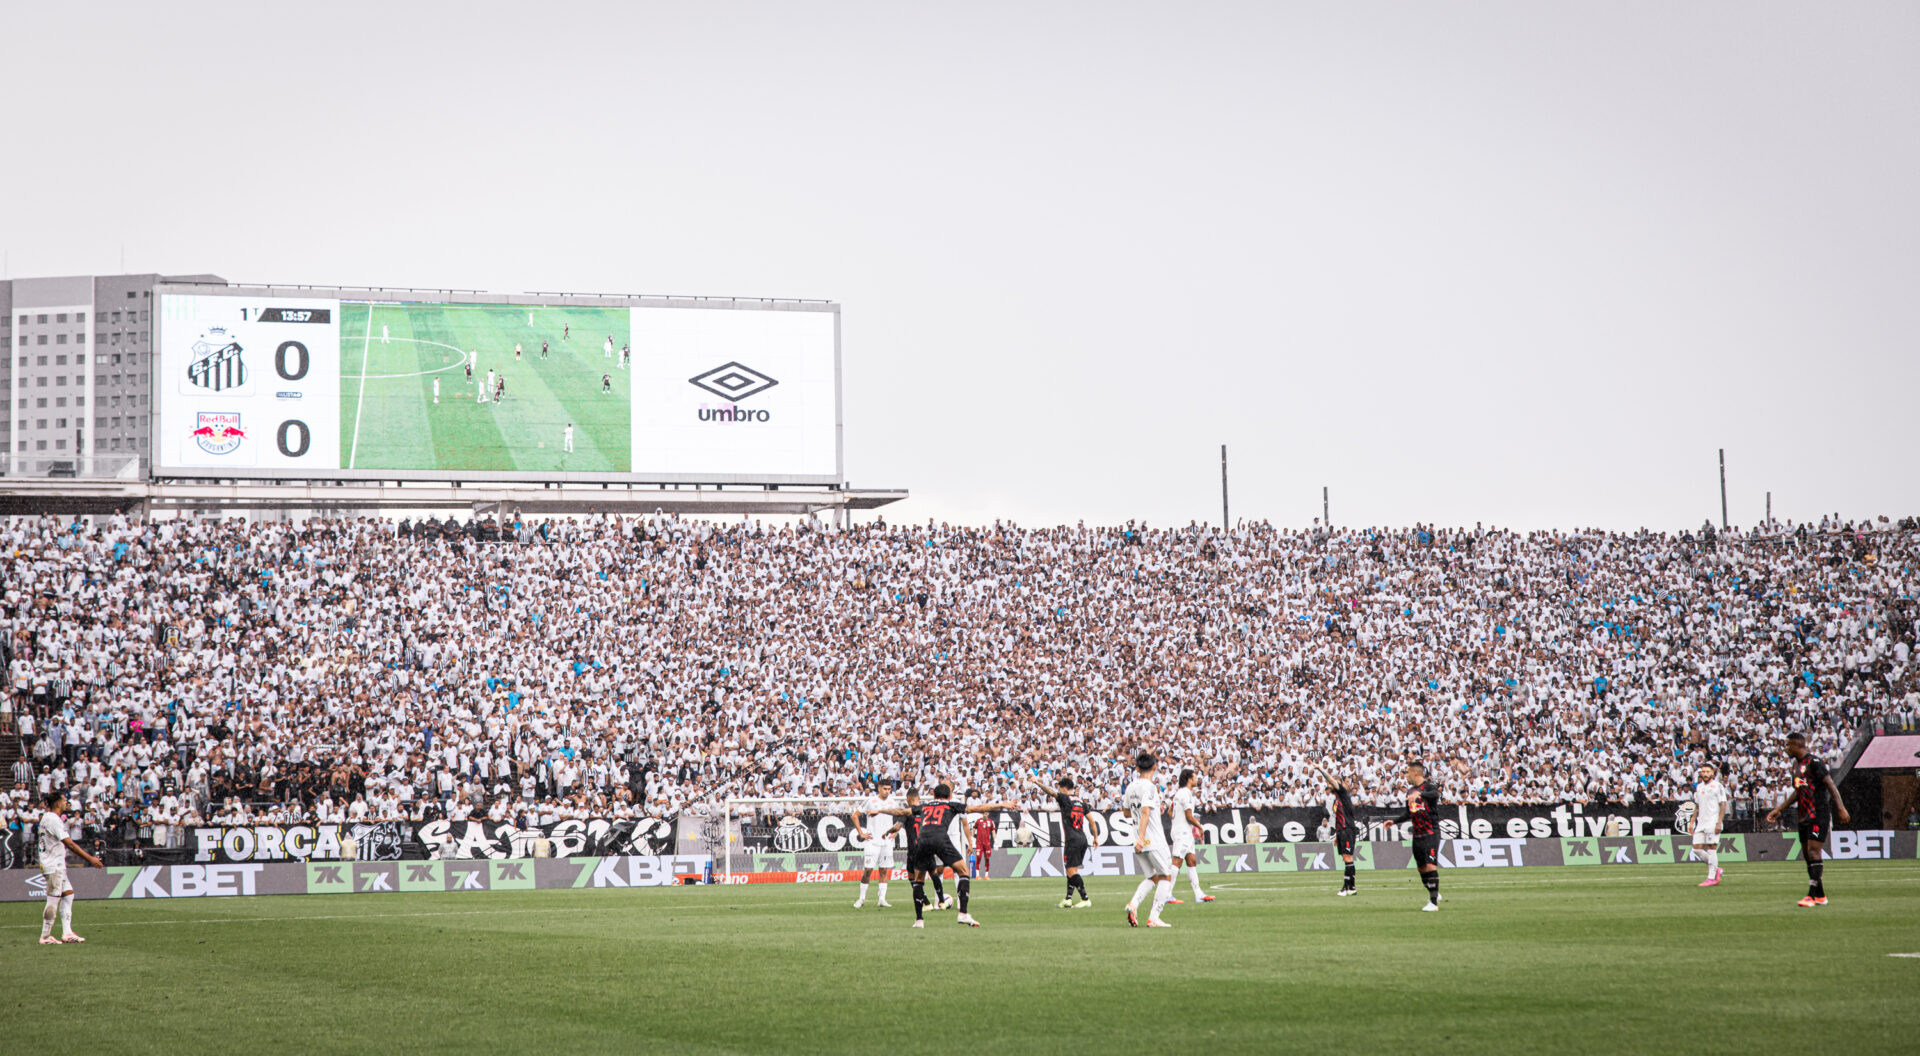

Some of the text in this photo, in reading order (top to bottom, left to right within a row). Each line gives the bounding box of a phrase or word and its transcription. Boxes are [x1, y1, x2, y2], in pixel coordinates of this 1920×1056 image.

[241, 308, 248, 321] 1
[281, 311, 312, 321] 13:57
[275, 340, 310, 381] 0
[698, 405, 770, 422] umbro
[277, 419, 311, 457] 0
[922, 805, 950, 826] 29
[1282, 821, 1306, 842] e
[1438, 804, 1493, 840] ele
[195, 825, 341, 863] FORÇA
[1567, 840, 1593, 857] 7K
[1640, 838, 1667, 855] 7K
[1224, 853, 1252, 872] 7K
[1262, 846, 1290, 863] 7K
[1301, 852, 1330, 870] 7K
[1604, 846, 1632, 863] 7K
[314, 866, 344, 884] 7K
[406, 864, 437, 882] 7K
[451, 870, 484, 889] 7K
[496, 862, 527, 880] 7K
[569, 855, 712, 888] 7KBET
[796, 870, 844, 883] Betano
[106, 863, 264, 899] 7KBET
[360, 872, 393, 891] 7K
